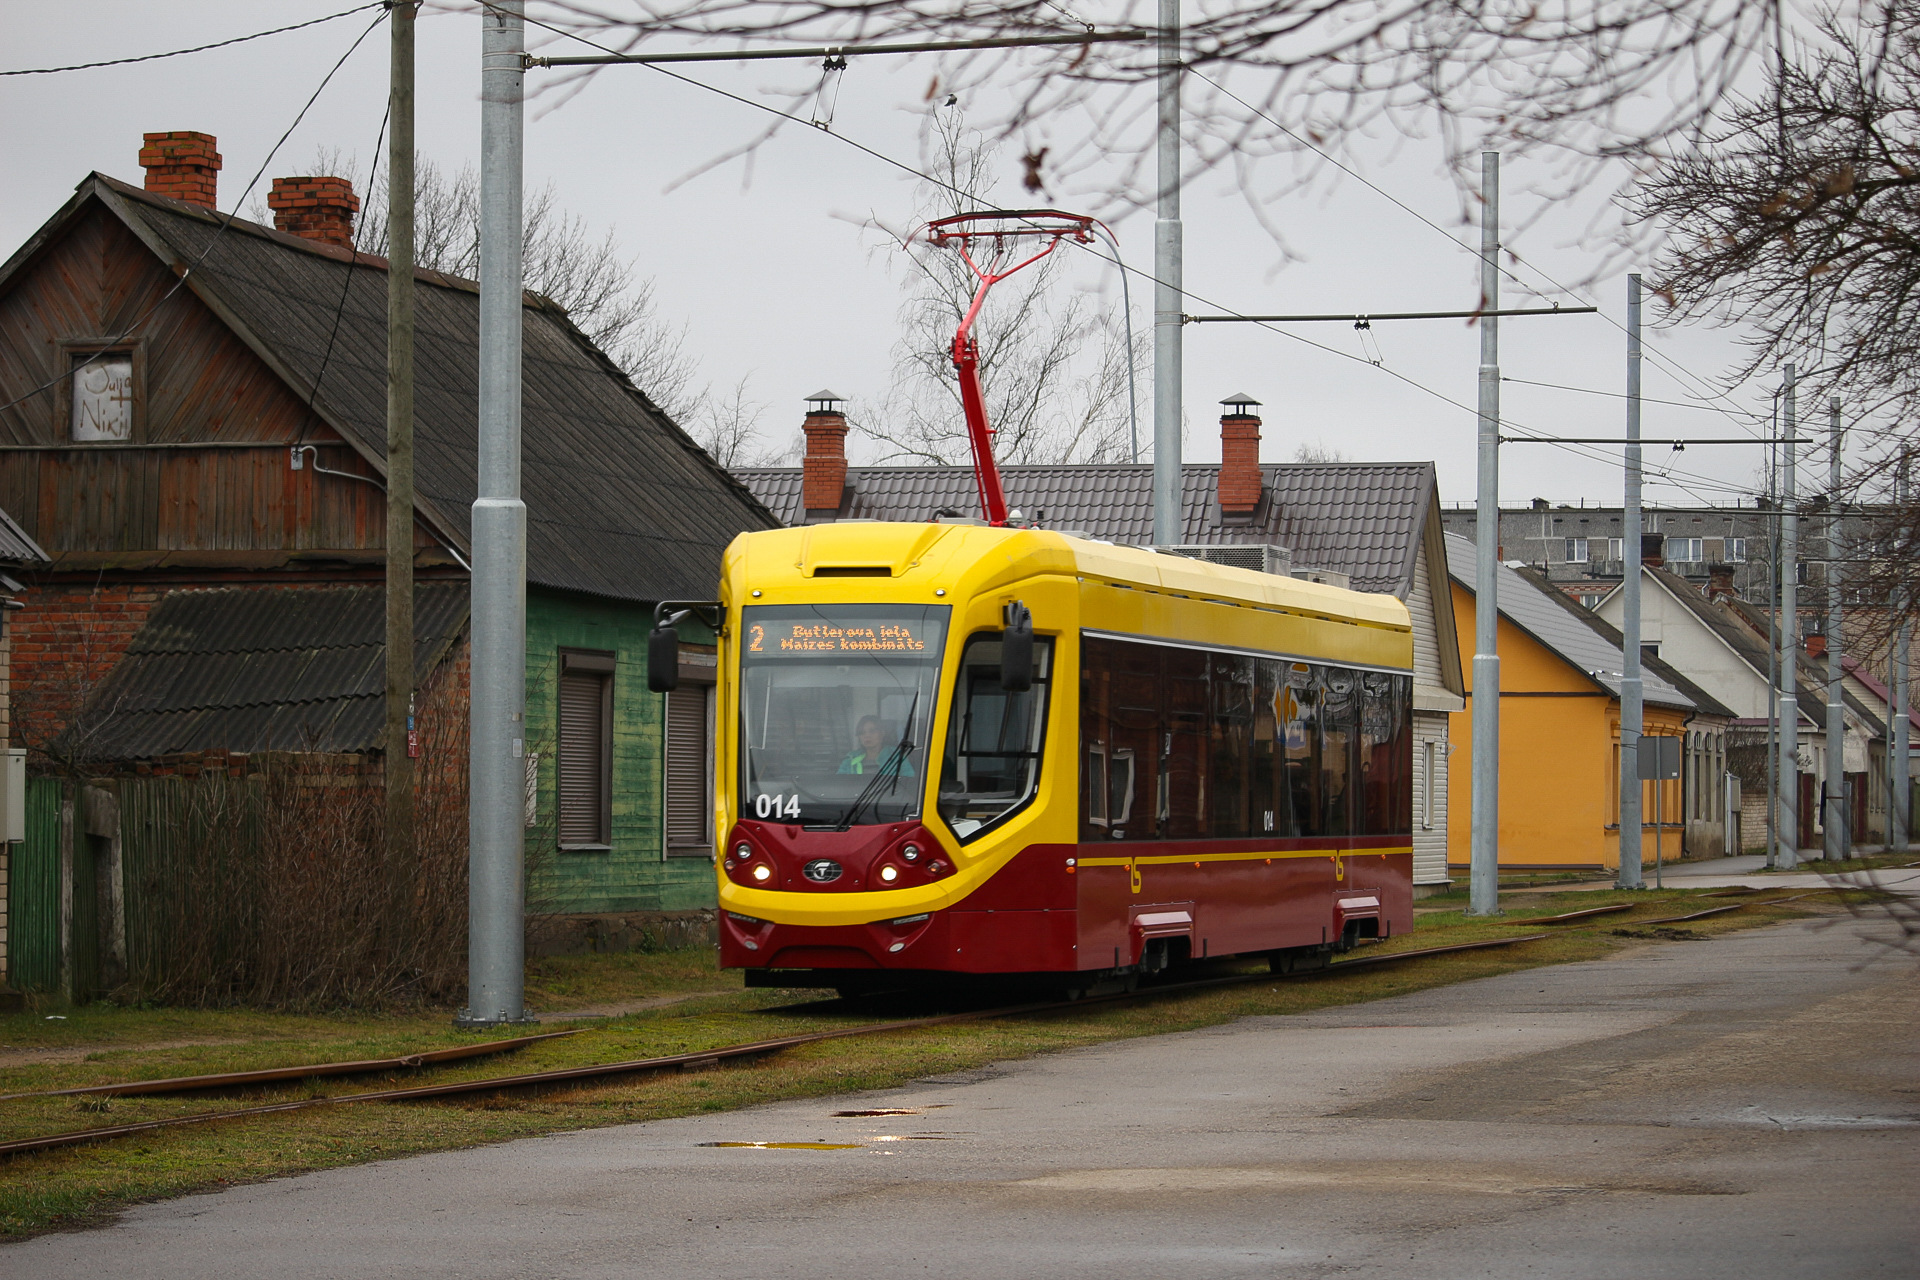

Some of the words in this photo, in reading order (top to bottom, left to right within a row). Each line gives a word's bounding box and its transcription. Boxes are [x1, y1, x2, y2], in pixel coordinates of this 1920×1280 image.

[750, 625, 765, 651] 2
[880, 625, 911, 638] iela
[780, 638, 835, 650] Maizes
[840, 638, 925, 650] kombināts
[755, 793, 801, 819] 014
[1263, 810, 1273, 831] 014
